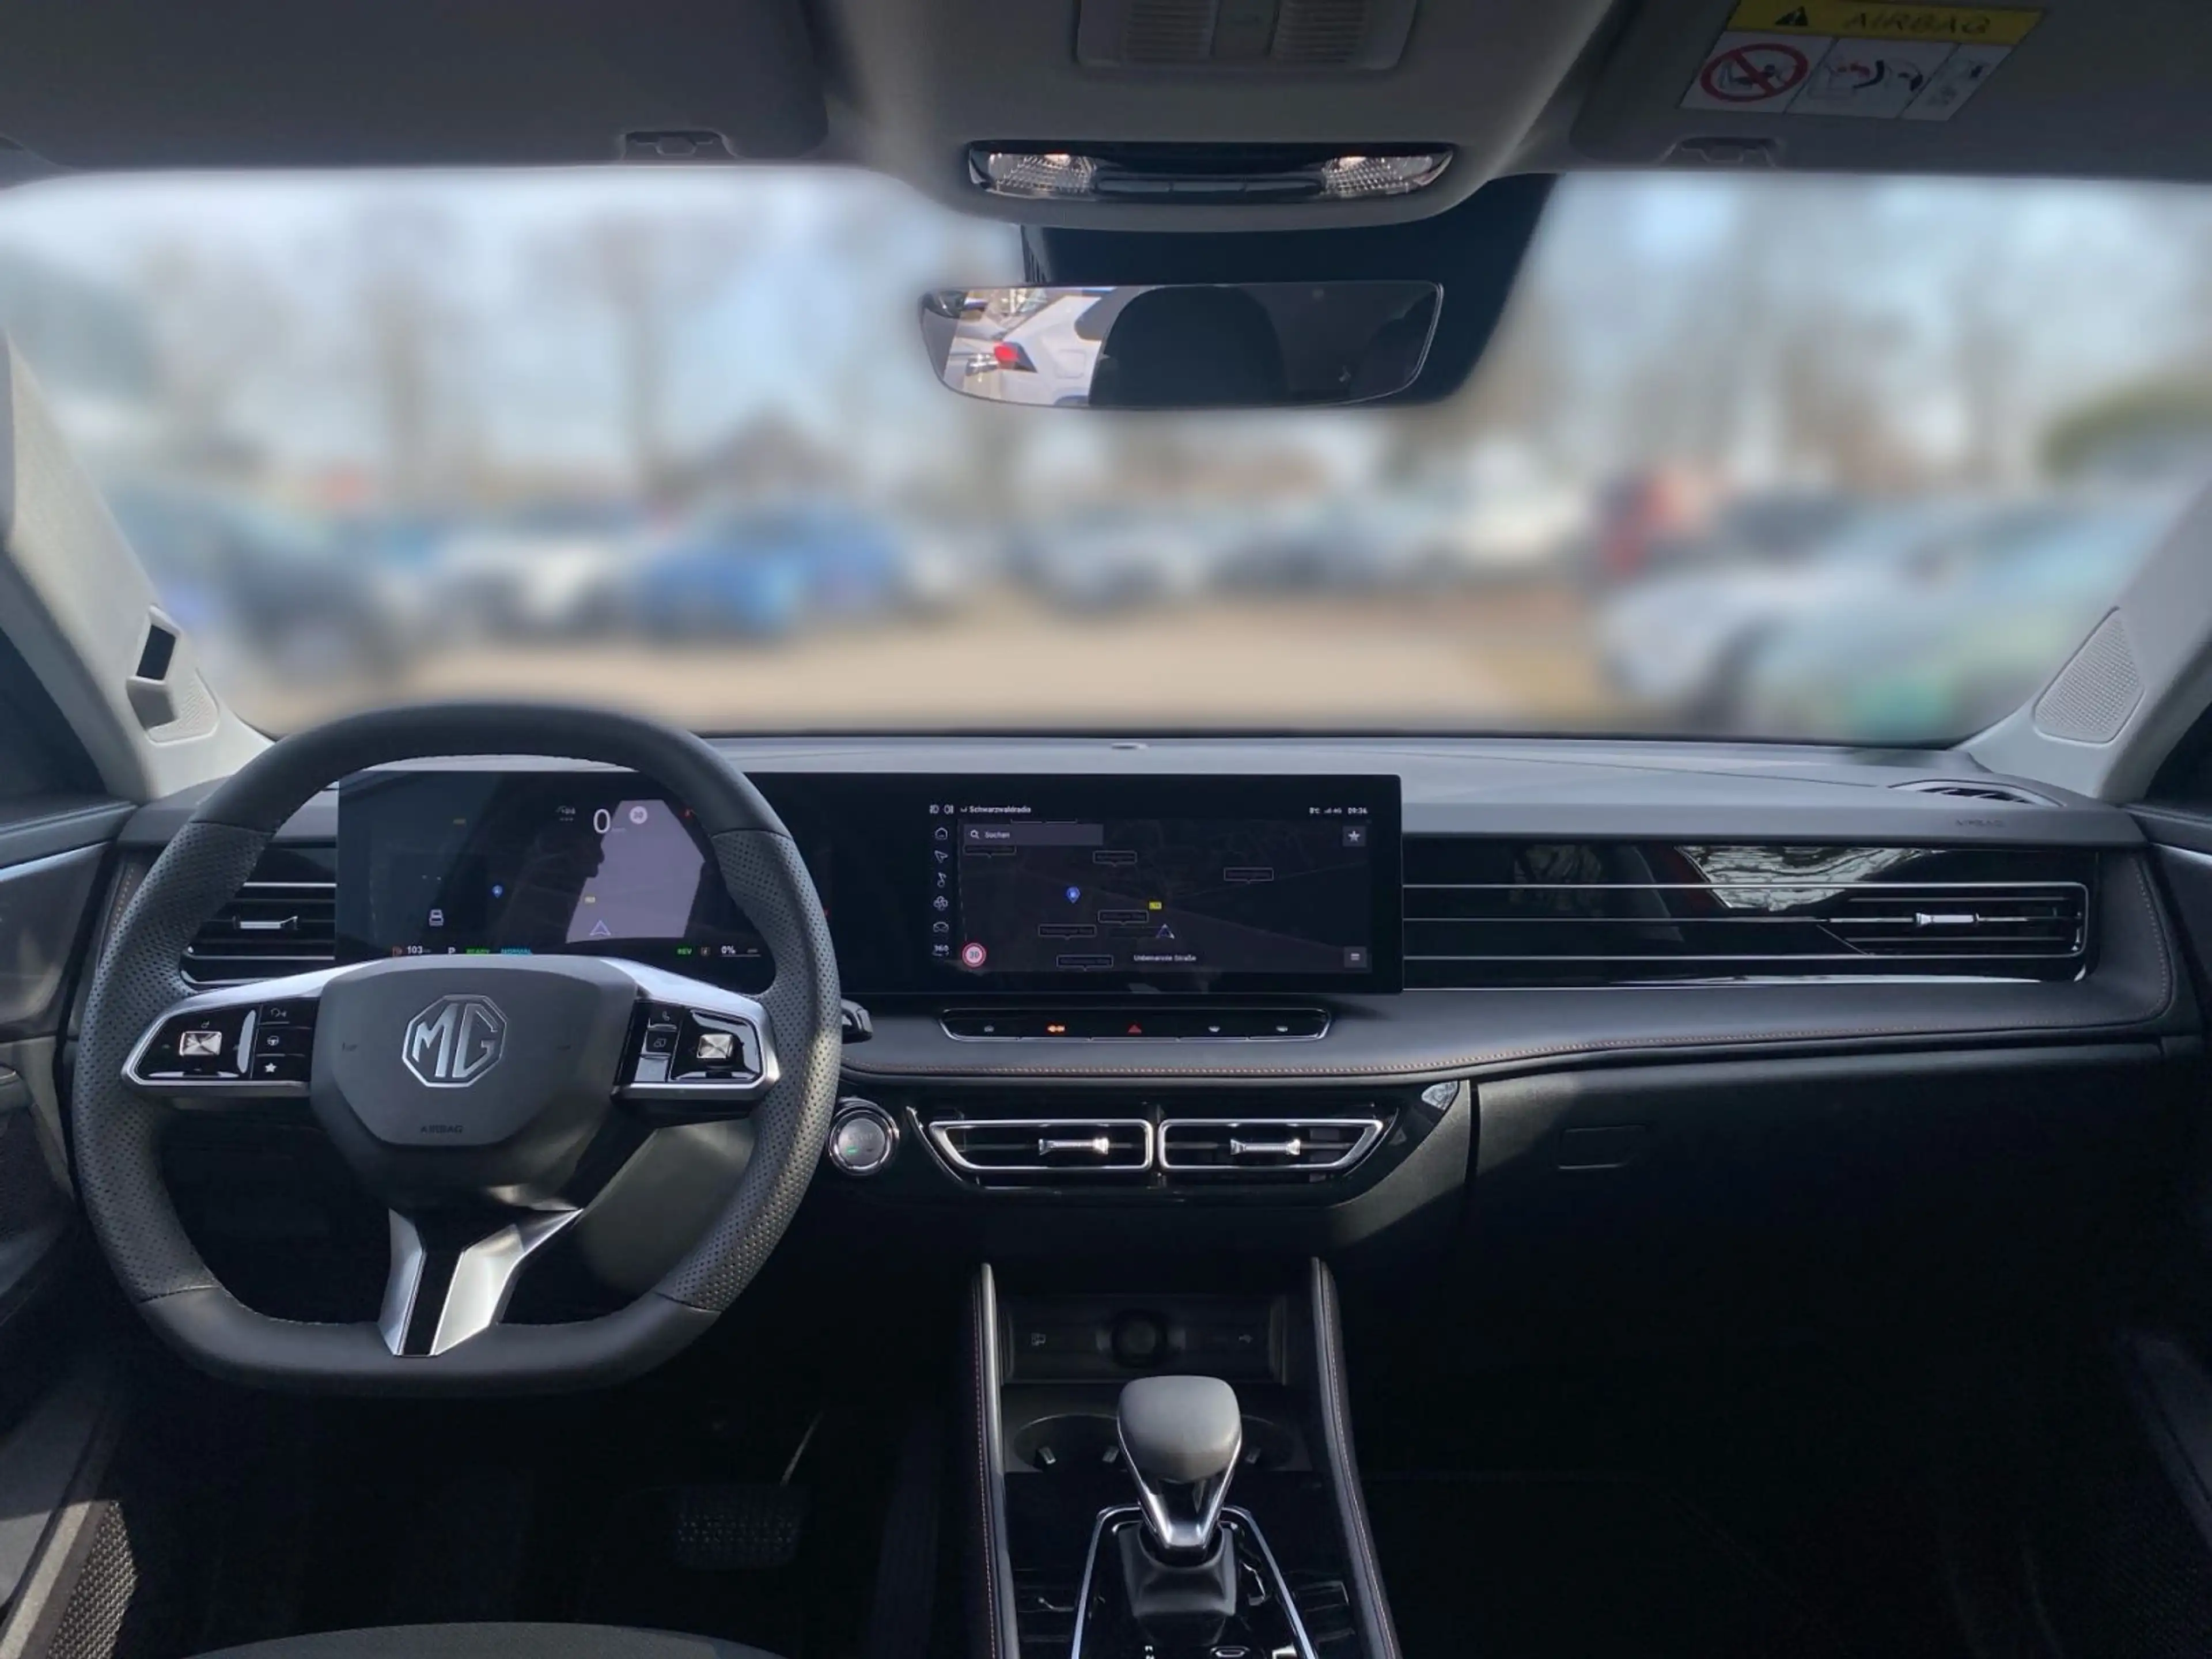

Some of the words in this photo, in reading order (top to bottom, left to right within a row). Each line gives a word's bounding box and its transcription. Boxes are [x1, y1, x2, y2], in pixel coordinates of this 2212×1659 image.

[1842, 12, 1990, 33] AIRBAG
[593, 808, 611, 834] 0
[407, 946, 423, 954] 103
[448, 946, 456, 955] P
[721, 945, 736, 955] 0%
[969, 951, 980, 959] 30
[412, 1003, 499, 1078] MG
[421, 1125, 463, 1134] AIRBAG
